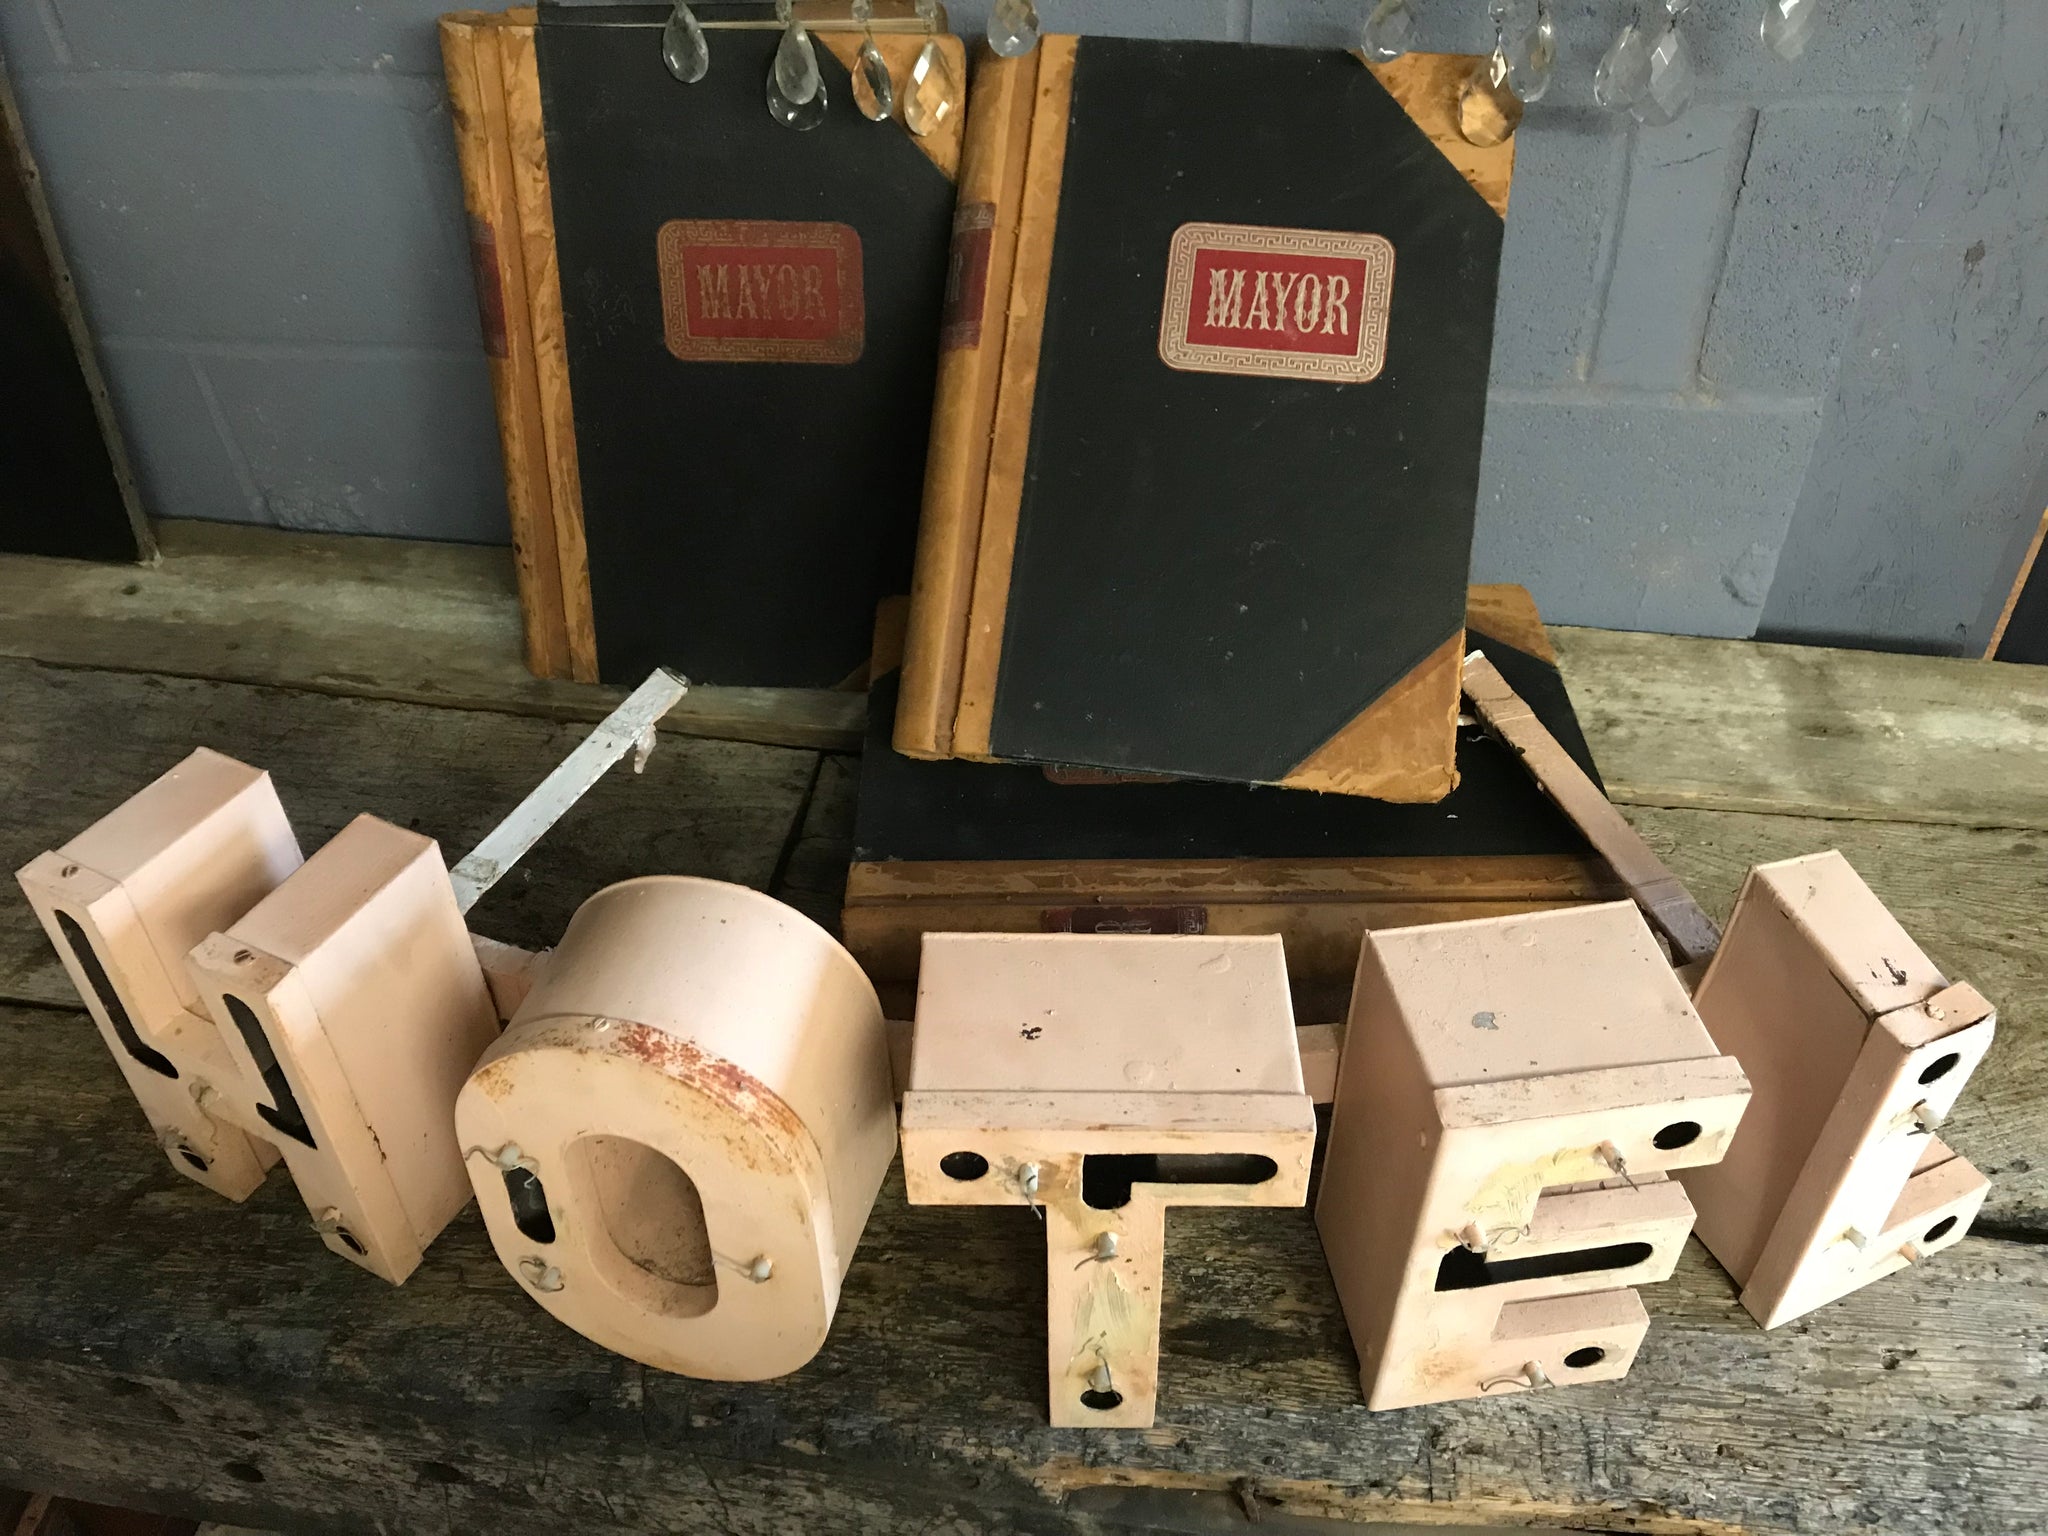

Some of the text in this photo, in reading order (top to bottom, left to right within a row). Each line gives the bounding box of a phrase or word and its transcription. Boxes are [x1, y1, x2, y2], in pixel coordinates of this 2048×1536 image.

[696, 263, 828, 321] MAYOR
[1204, 267, 1351, 336] MAYOR
[16, 747, 1998, 1431] HOTEL
